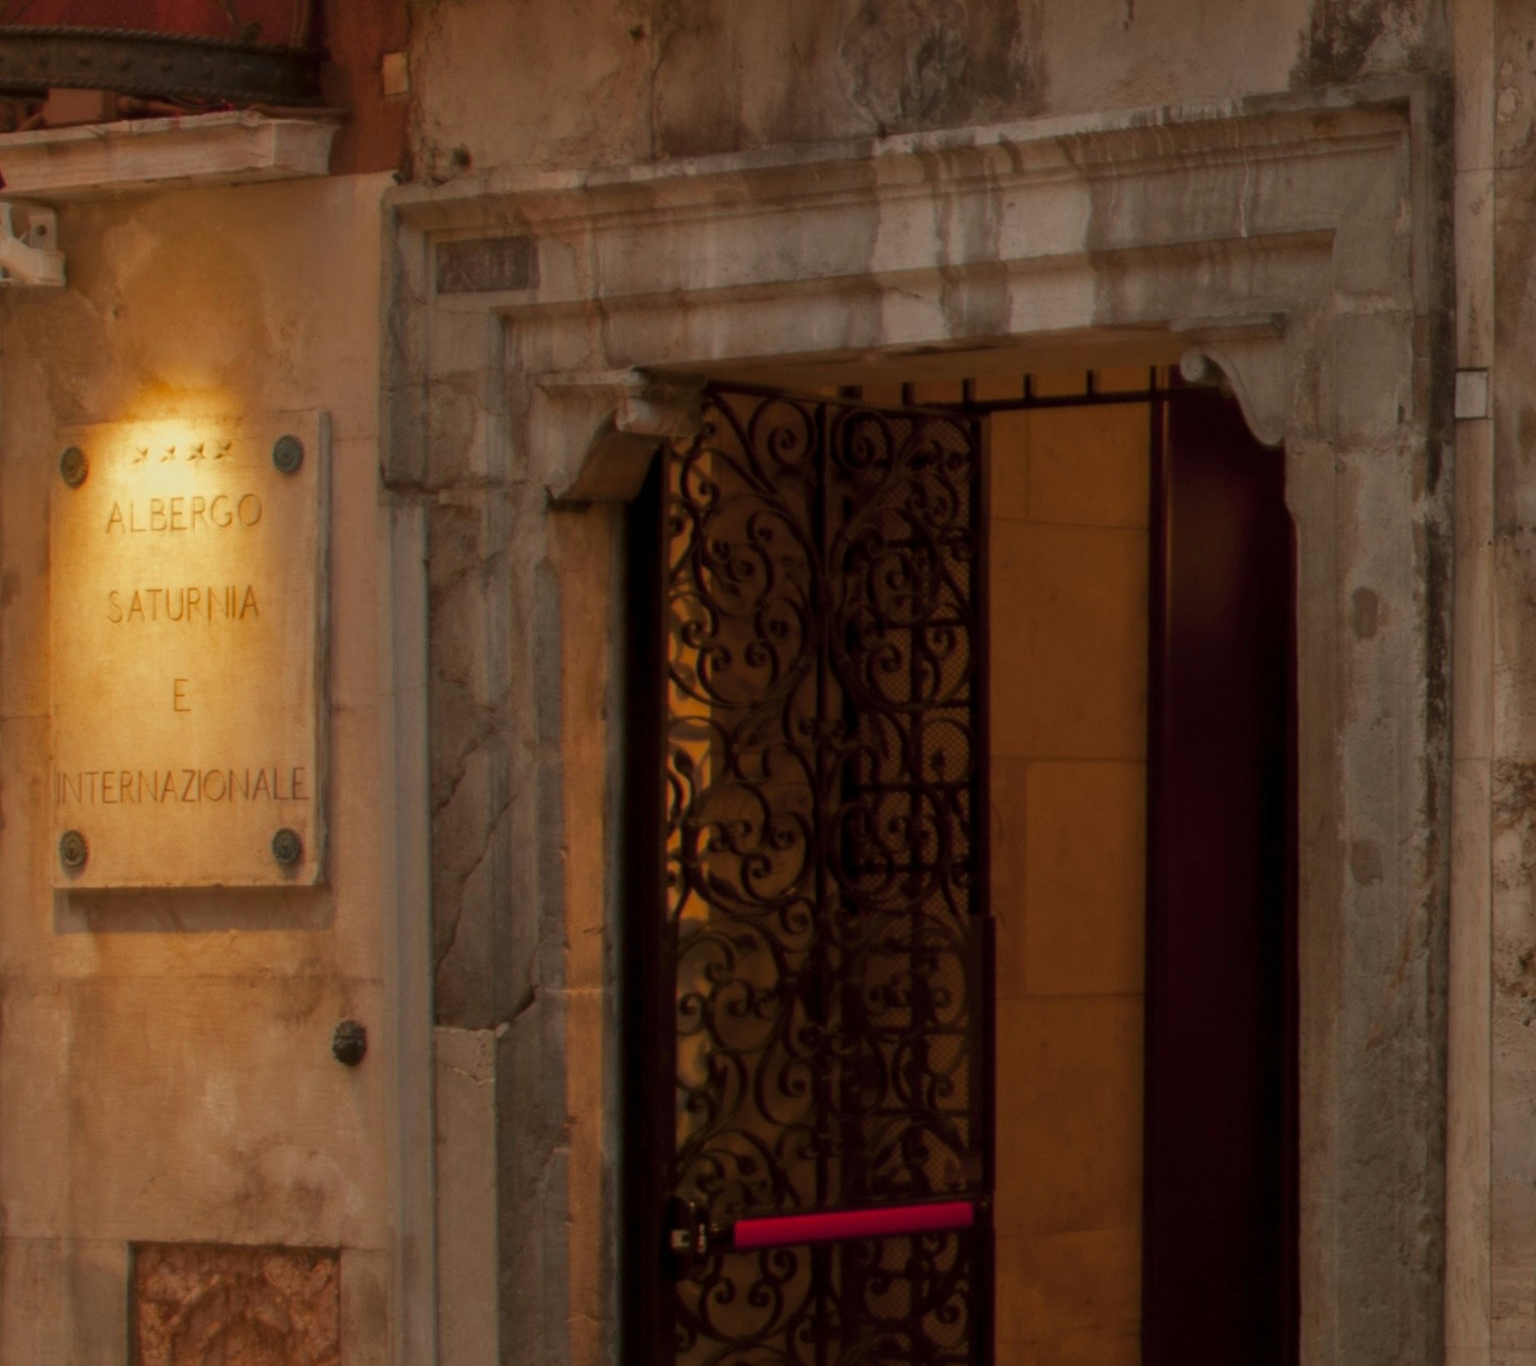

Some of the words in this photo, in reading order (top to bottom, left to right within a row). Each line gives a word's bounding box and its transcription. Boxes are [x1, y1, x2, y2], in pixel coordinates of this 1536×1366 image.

[105, 492, 264, 535] ALBERGO
[106, 584, 260, 625] SATURNIA
[172, 678, 192, 713] E
[56, 766, 310, 805] INTERNAZIONALE
